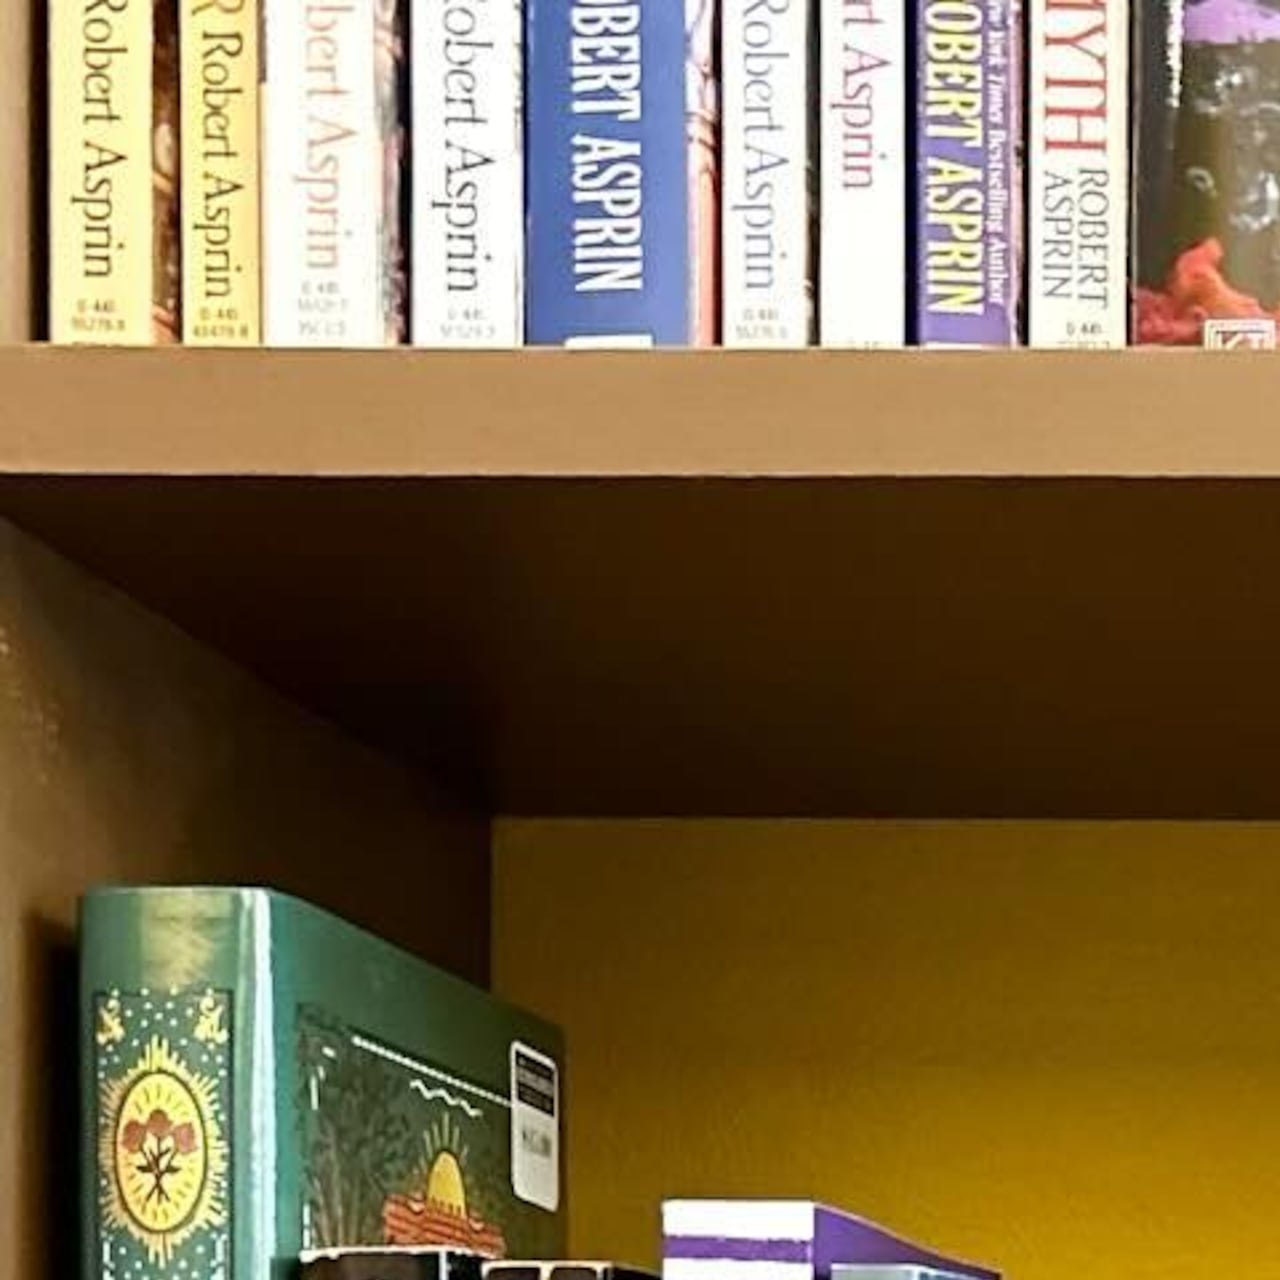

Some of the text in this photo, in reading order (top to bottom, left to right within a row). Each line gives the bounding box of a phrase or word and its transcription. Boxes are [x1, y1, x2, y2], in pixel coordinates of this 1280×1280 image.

[82, 0, 128, 124] Robert
[201, 32, 244, 160] Robert
[741, 0, 790, 137] Robert
[830, 44, 892, 190] Asprin
[72, 142, 128, 278] Asprin
[192, 176, 244, 299] Asprin
[293, 118, 357, 270] Asprin
[432, 143, 496, 293] Asprin
[570, 136, 643, 291] ASPRIN
[730, 145, 789, 289] Asprin
[926, 157, 984, 317] ASPRIN
[1042, 171, 1074, 301] ASPRIN
[1078, 169, 1110, 310] ROBERT
